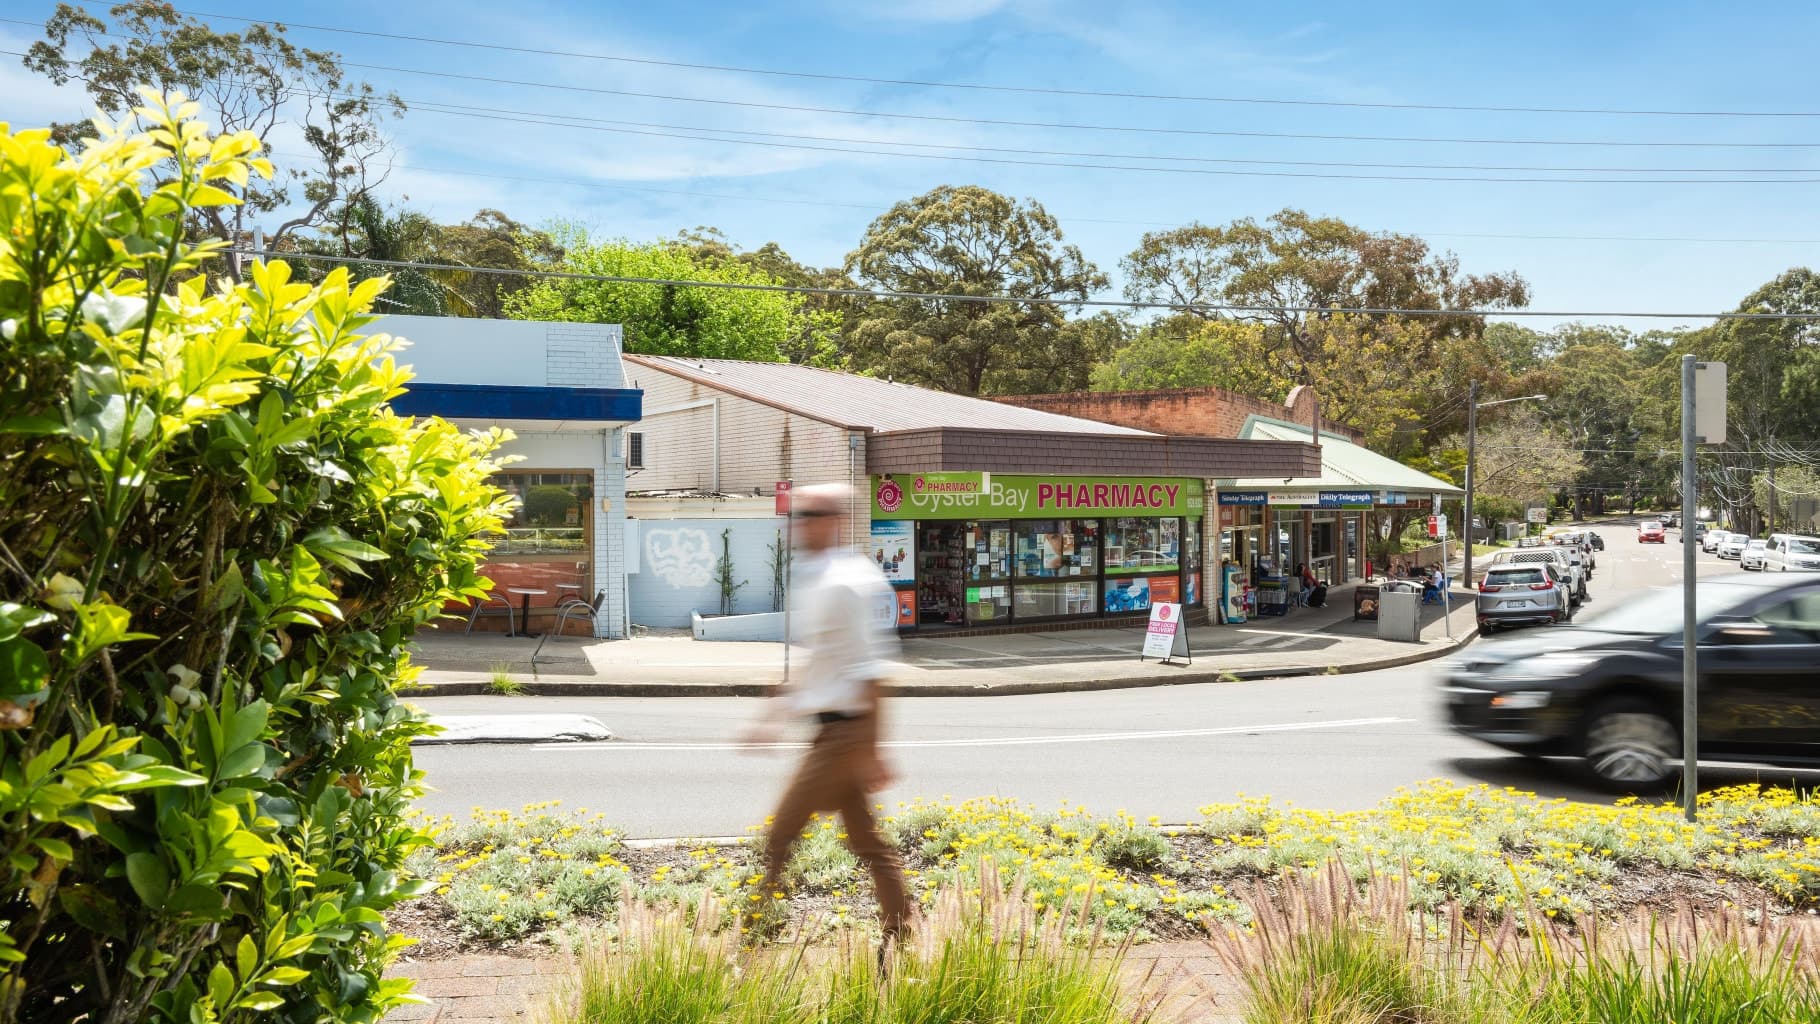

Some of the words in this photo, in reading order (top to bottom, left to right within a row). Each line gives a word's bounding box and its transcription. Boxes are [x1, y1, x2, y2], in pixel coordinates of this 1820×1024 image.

[928, 482, 978, 492] PHARMACY
[990, 483, 1029, 512] Bay
[1037, 483, 1180, 509] PHARMACY
[1320, 493, 1338, 502] Daily
[1338, 493, 1371, 502] Telegraph
